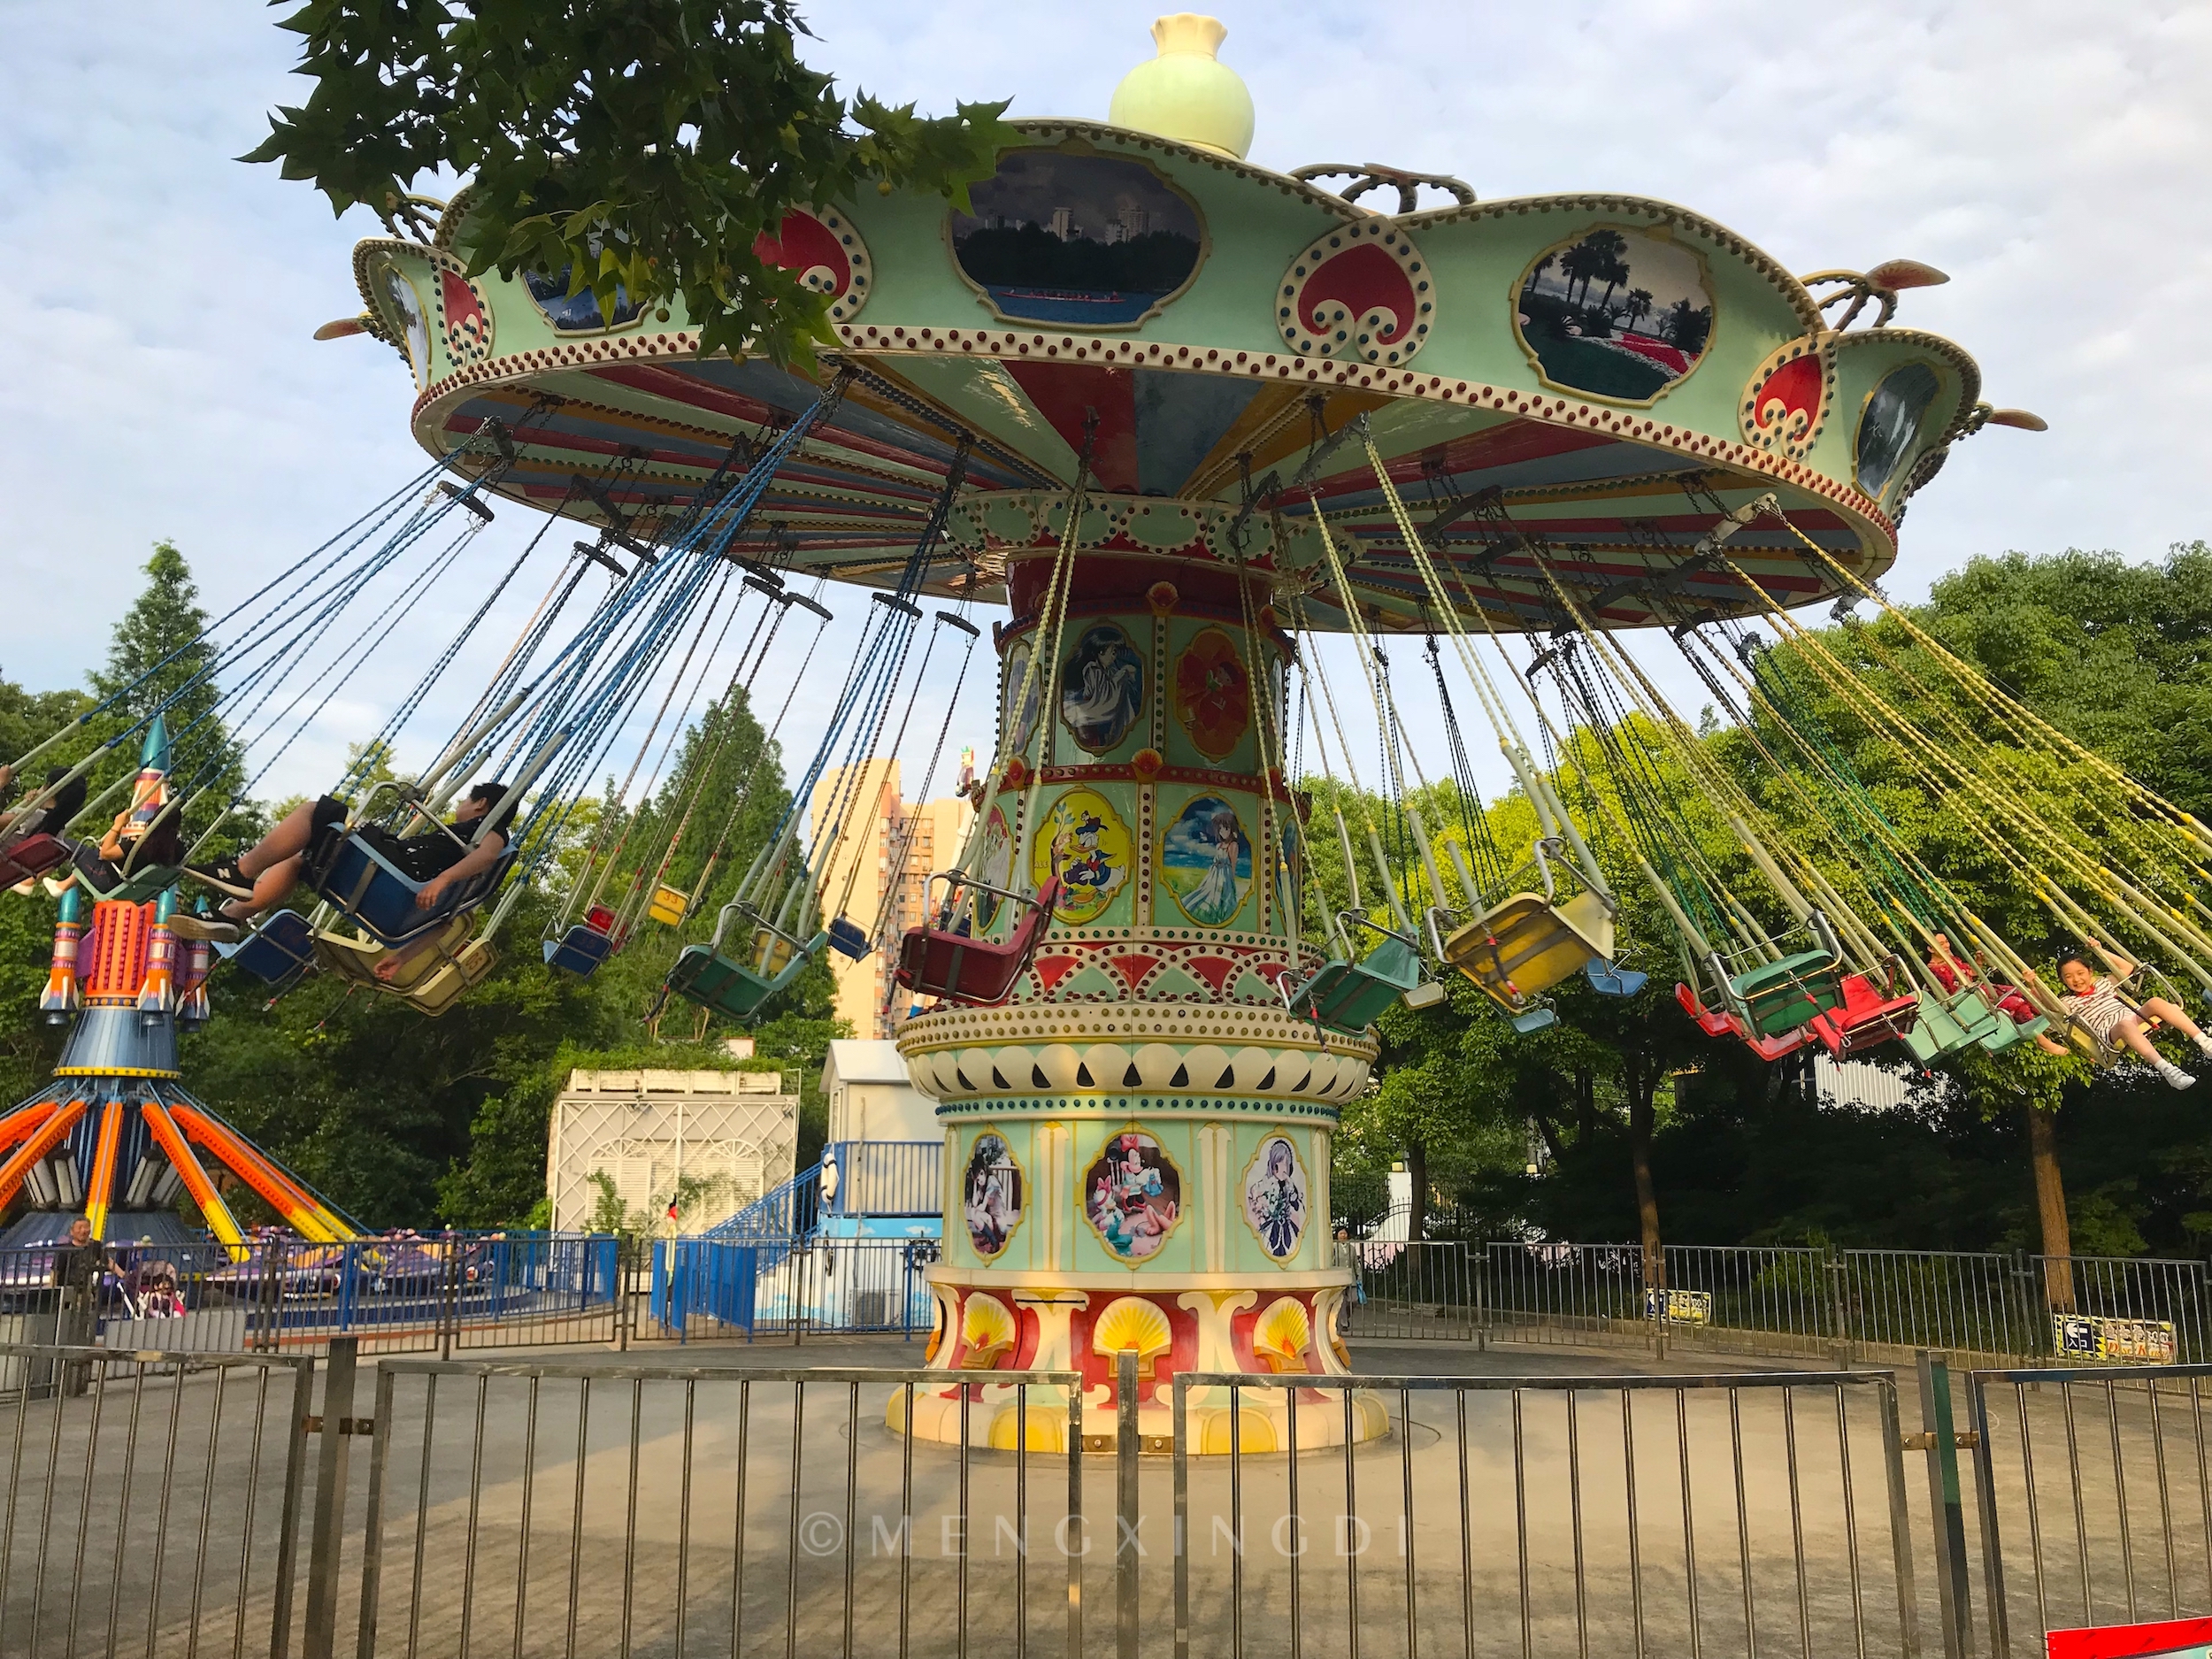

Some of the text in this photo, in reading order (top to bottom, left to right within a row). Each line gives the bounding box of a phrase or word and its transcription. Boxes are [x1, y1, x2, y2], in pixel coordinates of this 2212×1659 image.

[217, 868, 231, 879] N
[664, 891, 678, 904] 33
[2069, 1339, 2087, 1348] 入口
